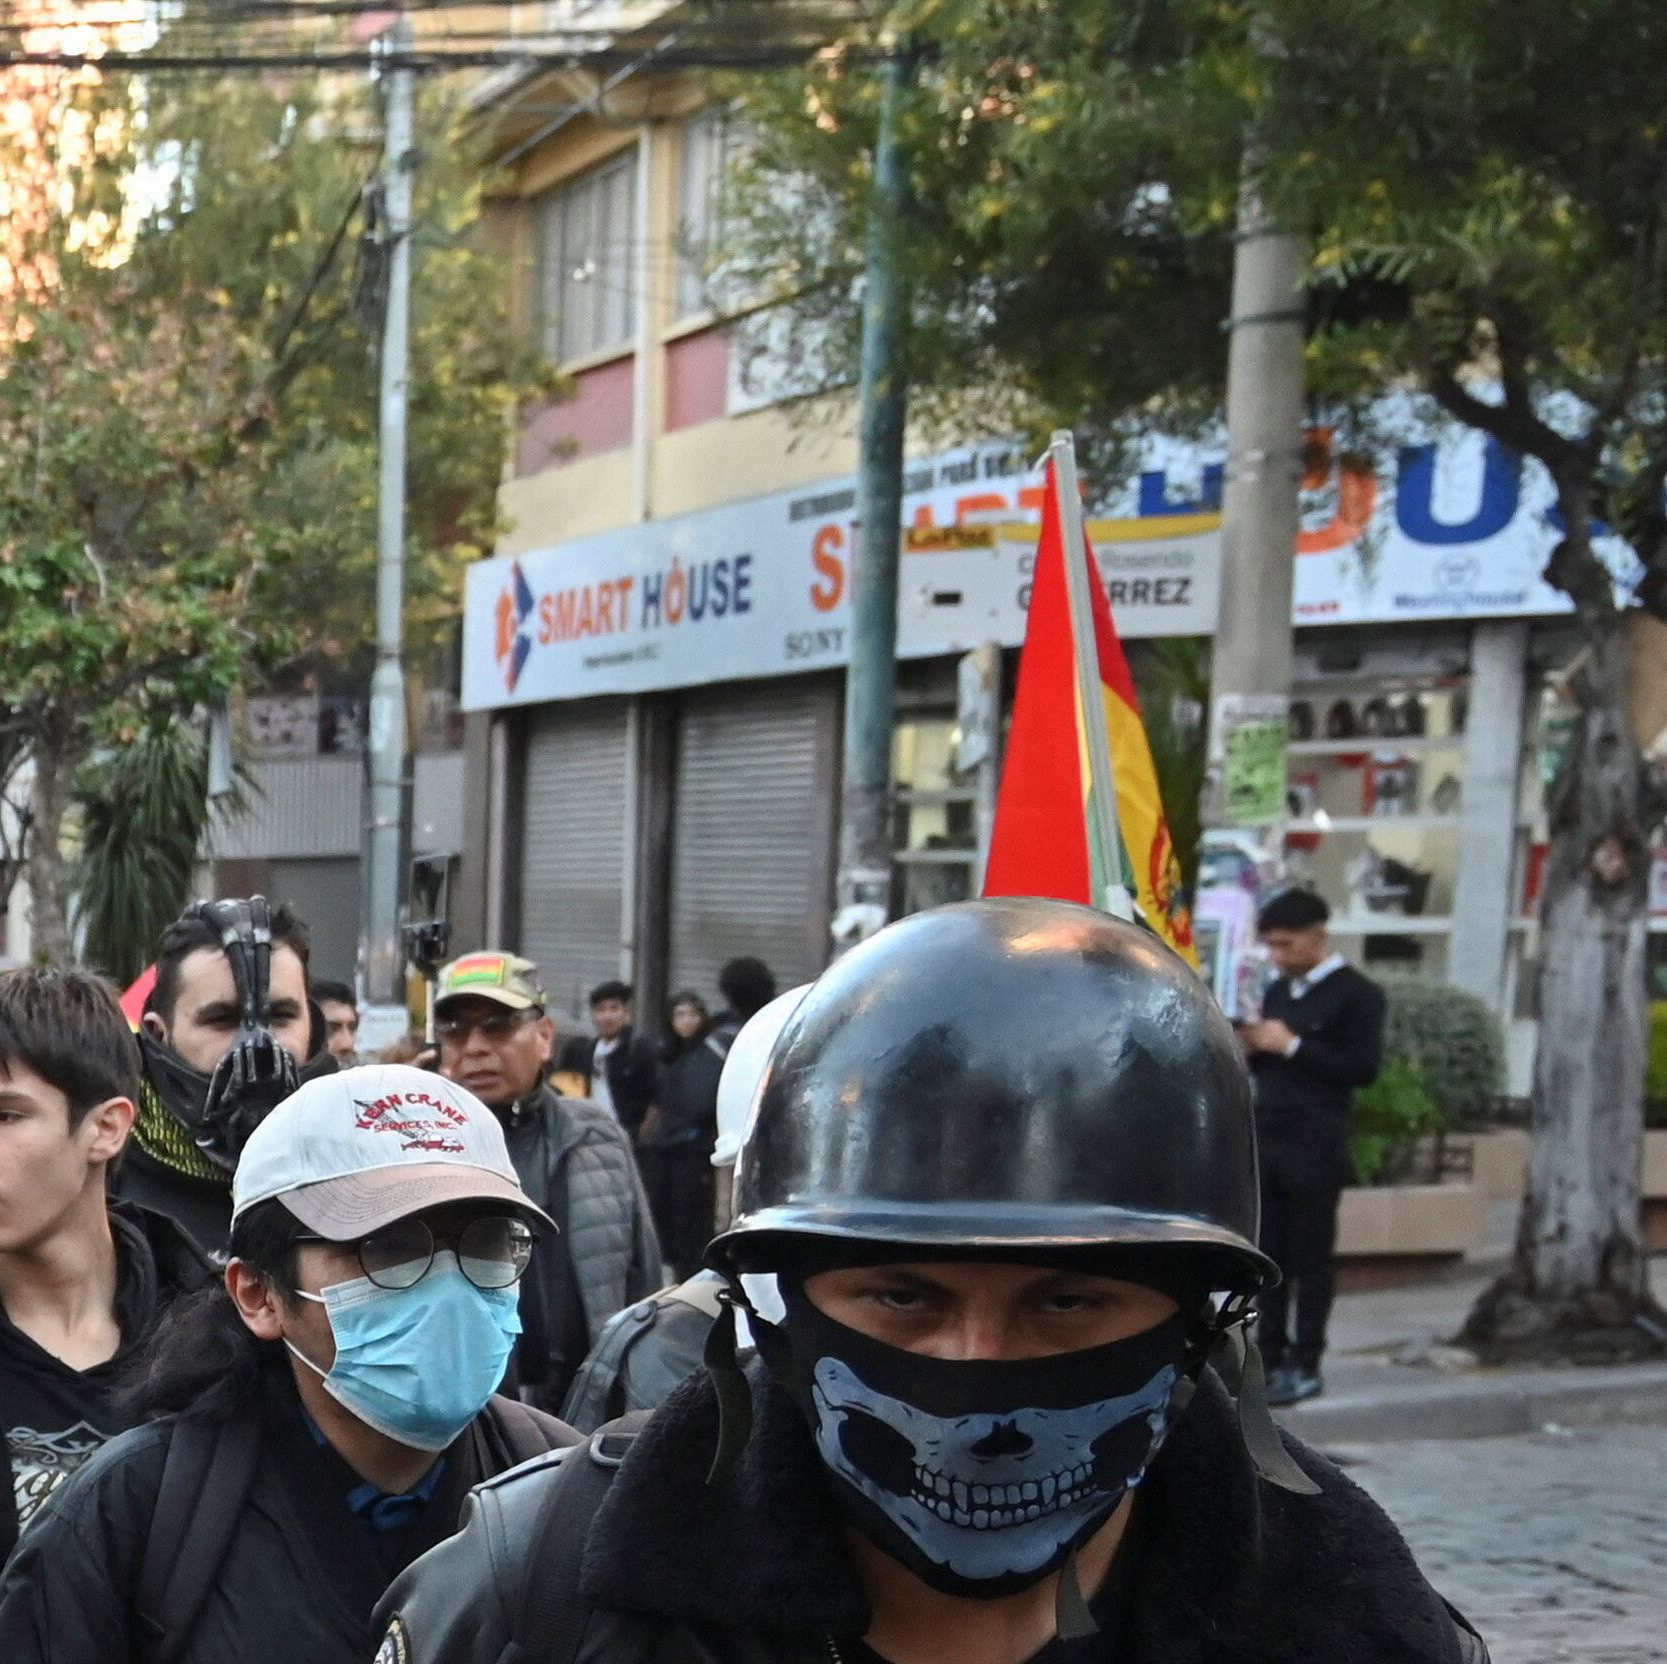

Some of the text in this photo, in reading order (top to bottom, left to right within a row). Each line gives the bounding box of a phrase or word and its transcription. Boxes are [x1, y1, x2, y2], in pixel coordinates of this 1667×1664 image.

[537, 574, 635, 645] SMART
[642, 553, 754, 629] HOUSE
[356, 1092, 467, 1130] KERN CRANE
